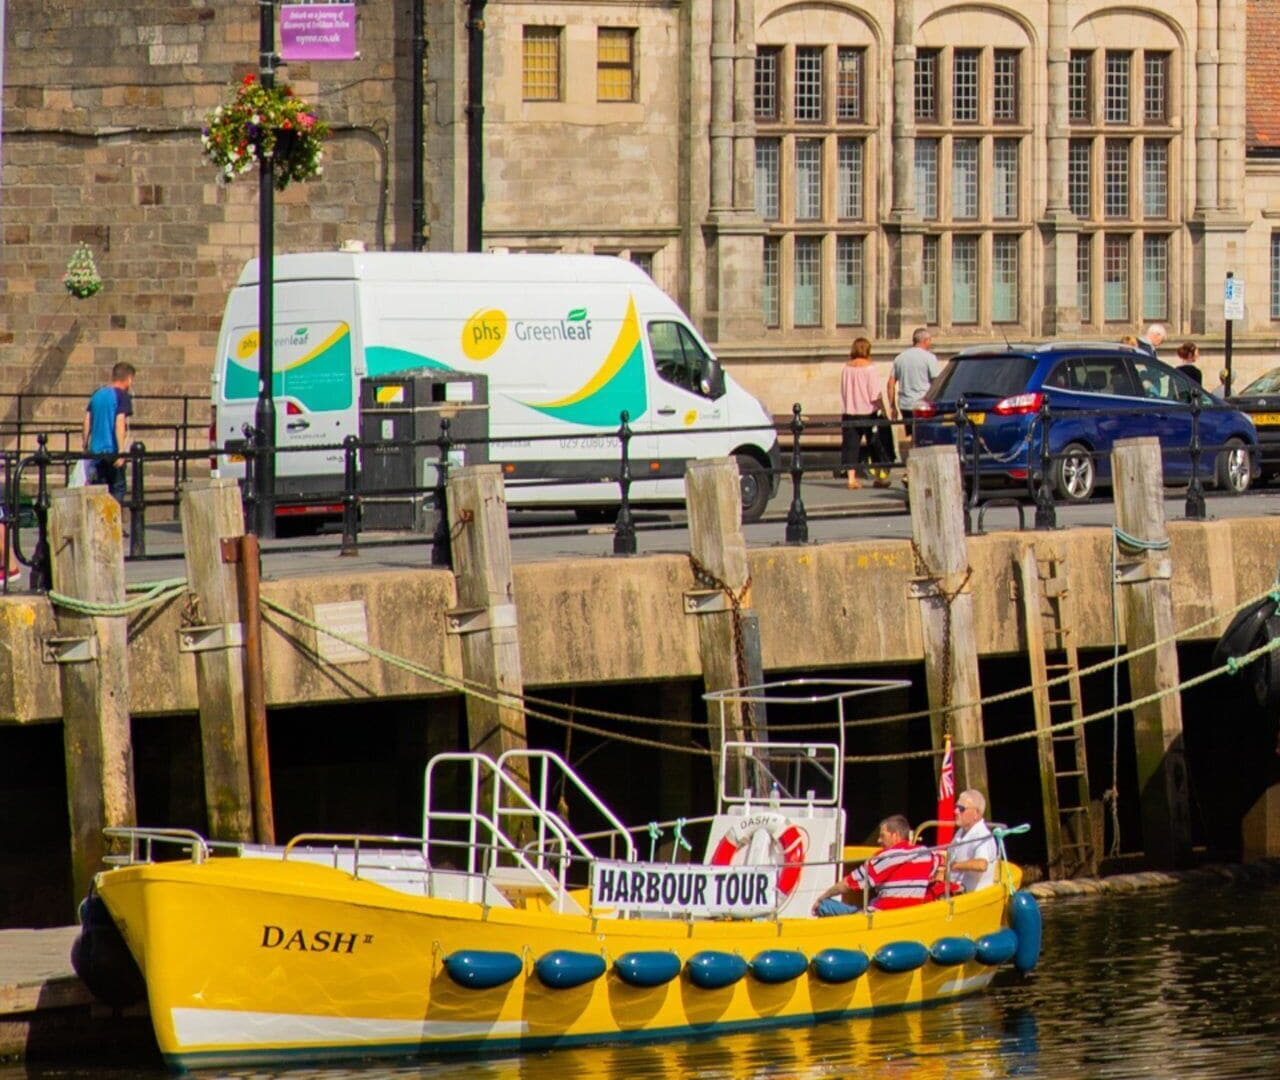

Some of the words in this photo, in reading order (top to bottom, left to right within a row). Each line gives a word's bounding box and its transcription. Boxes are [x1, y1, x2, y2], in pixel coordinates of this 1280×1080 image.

[274, 335, 309, 347] eenleaf
[473, 321, 501, 343] phs
[514, 320, 592, 341] Greenleaf
[740, 815, 770, 830] DASH
[598, 869, 708, 905] HARBOUR
[714, 872, 769, 905] TOUR
[262, 925, 358, 953] DASH
